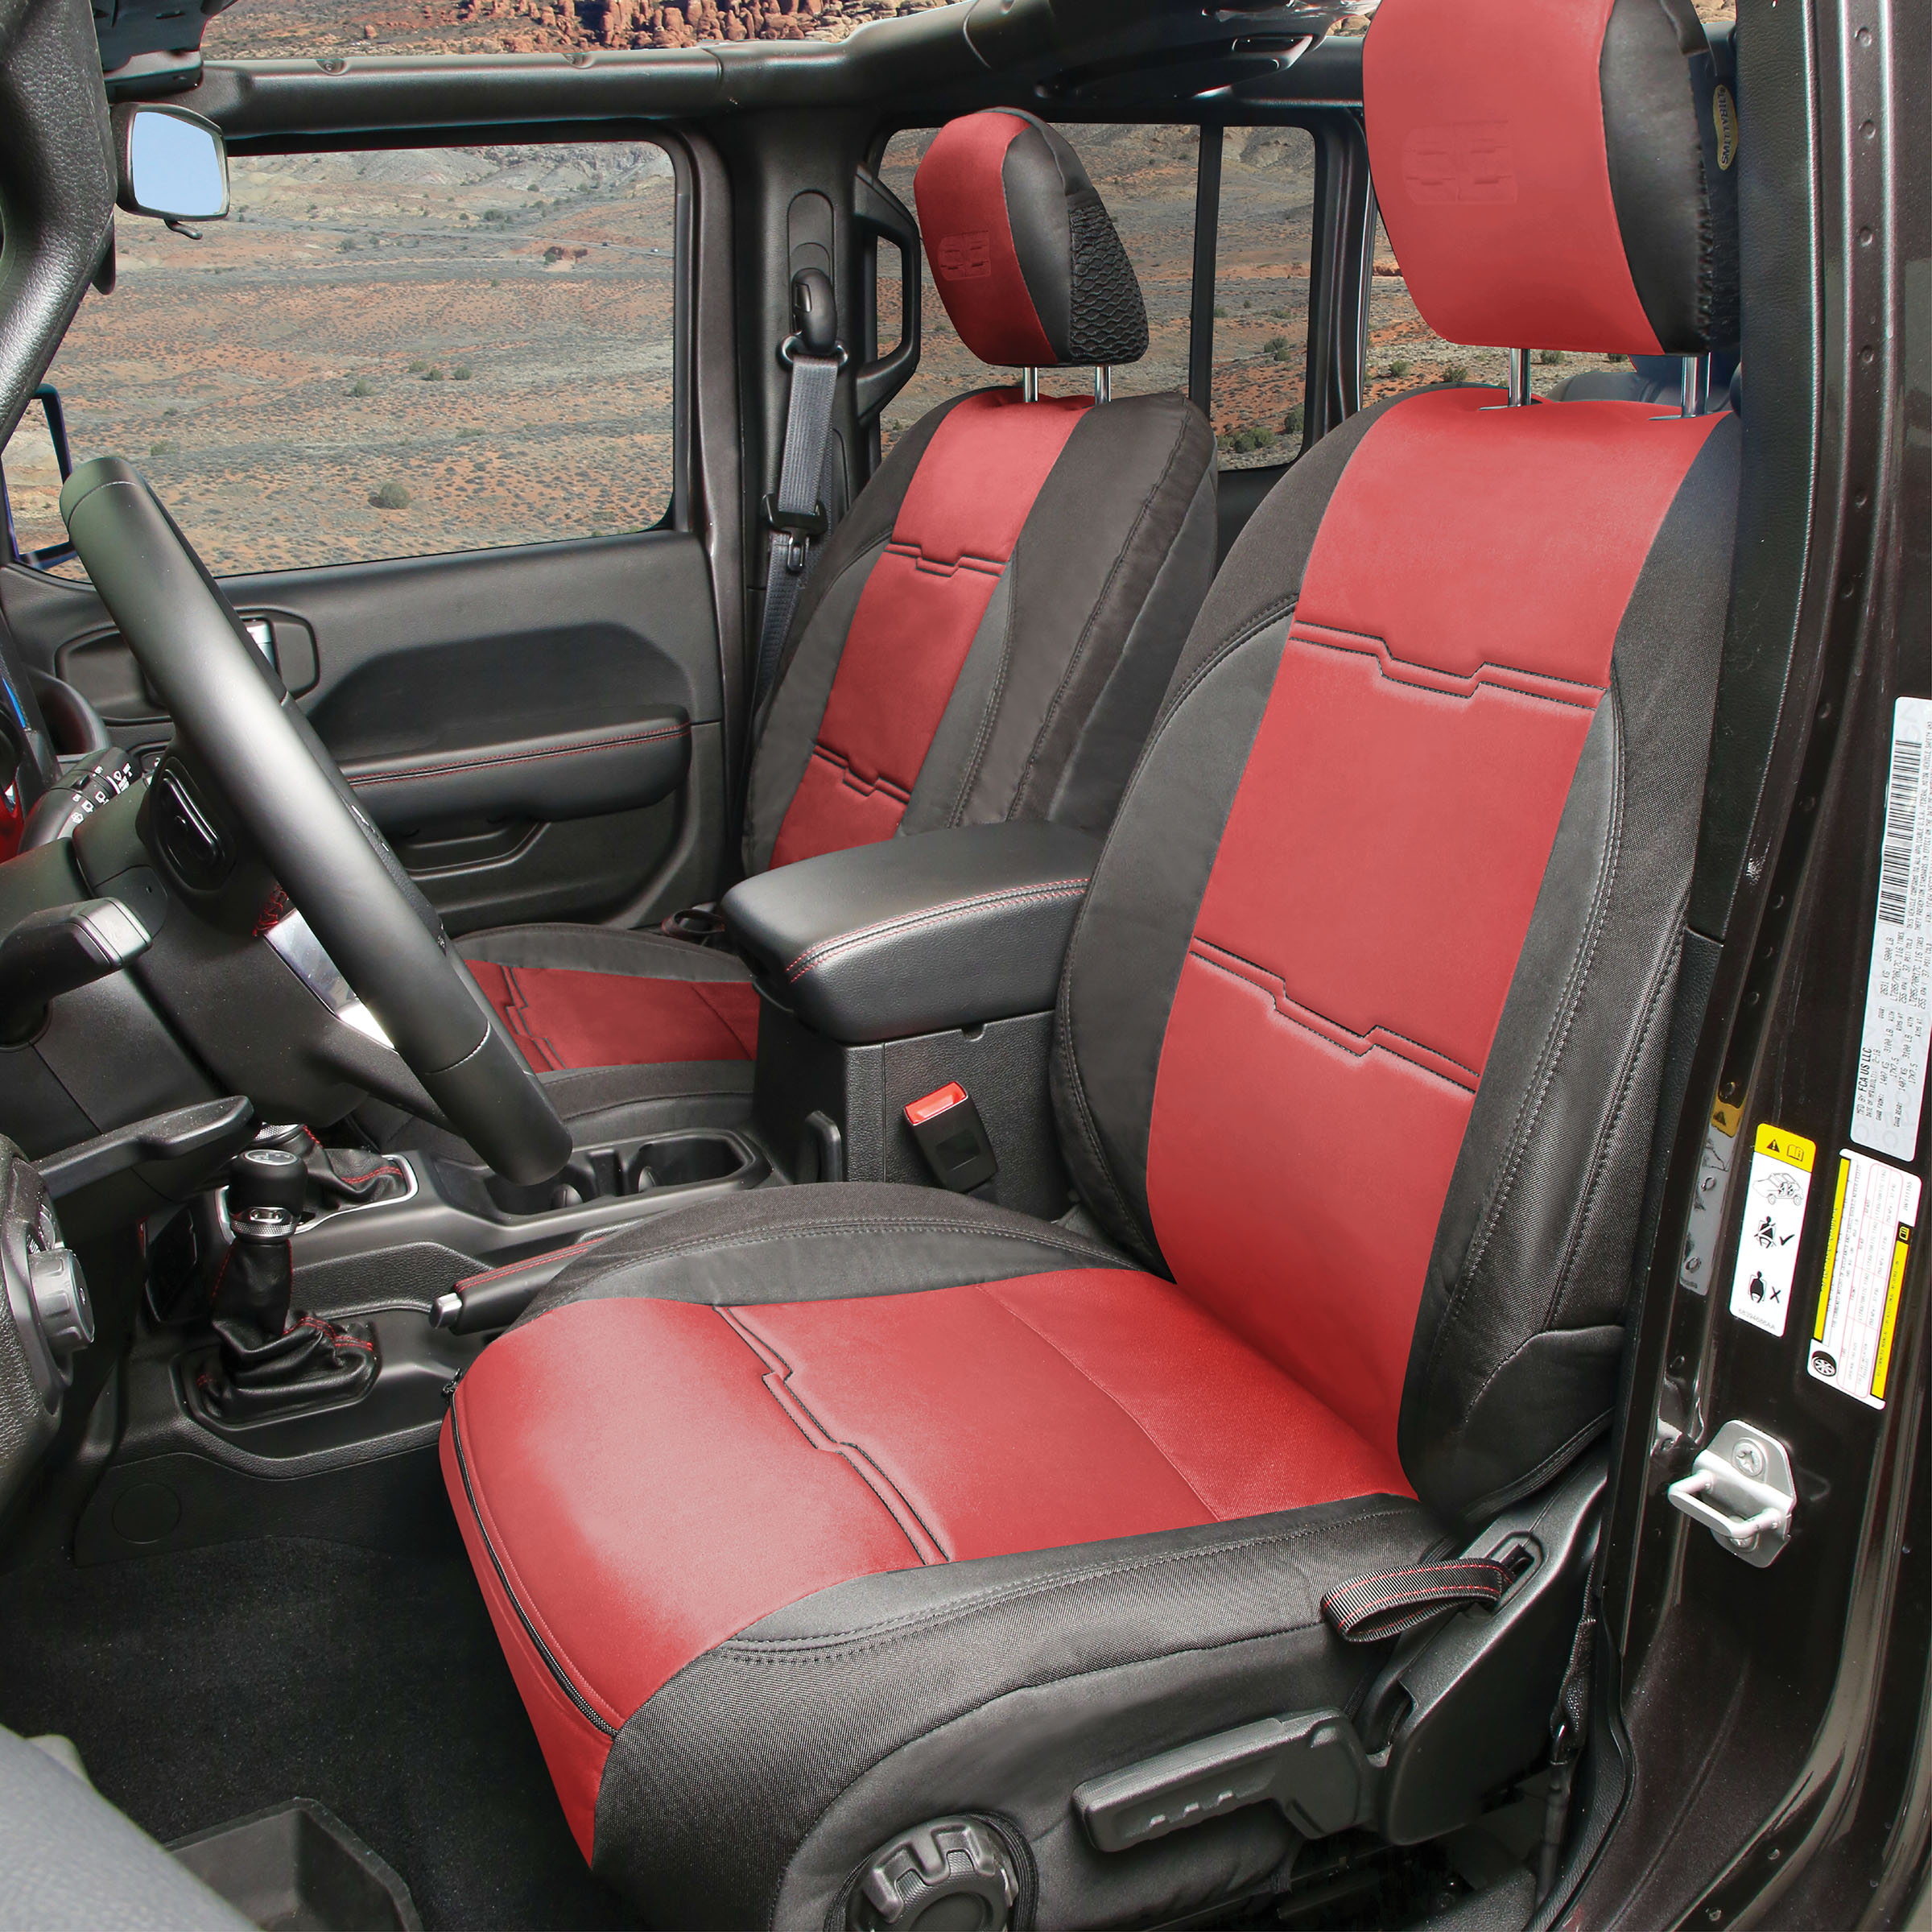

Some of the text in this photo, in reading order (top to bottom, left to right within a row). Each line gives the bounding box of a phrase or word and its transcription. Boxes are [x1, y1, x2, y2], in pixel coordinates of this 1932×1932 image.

[1885, 936, 1893, 945] LB
[1902, 964, 1910, 972] 37
[1882, 969, 1889, 978] KG
[1922, 969, 1929, 977] 37
[1885, 1028, 1893, 1036] LB
[1904, 1034, 1912, 1042] LB
[1883, 1038, 1892, 1053] 3100
[1861, 1046, 1871, 1062] LLC
[1902, 1043, 1910, 1059] 3100
[1860, 1063, 1869, 1075] US
[1881, 1061, 1889, 1069] KG
[1900, 1067, 1907, 1075] KG
[1858, 1076, 1868, 1092] FCA
